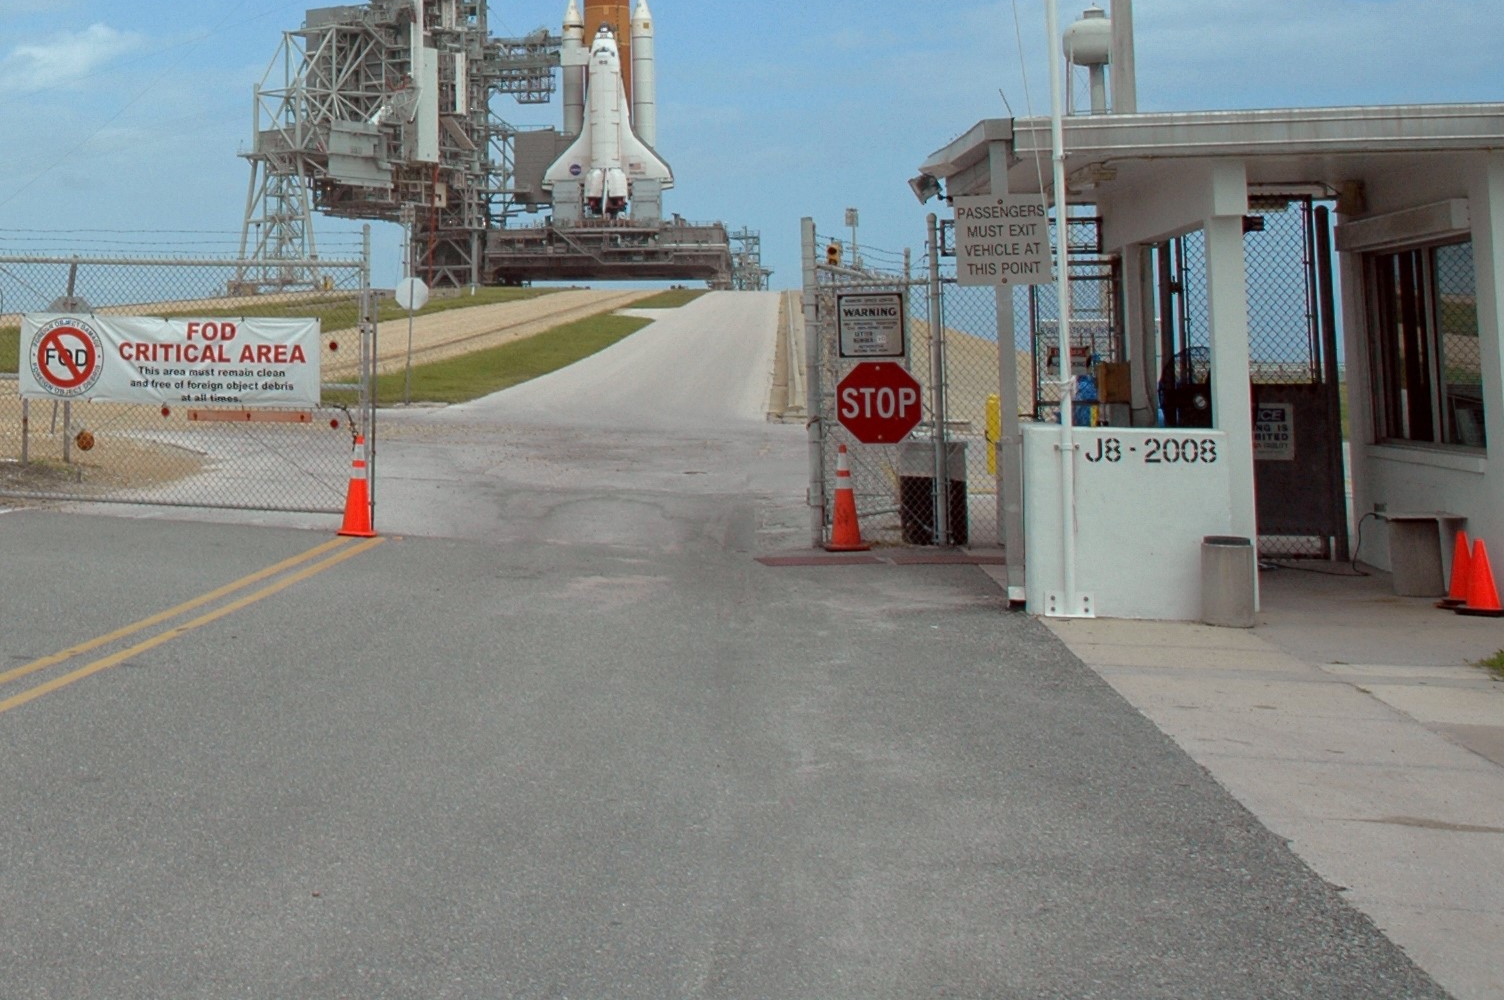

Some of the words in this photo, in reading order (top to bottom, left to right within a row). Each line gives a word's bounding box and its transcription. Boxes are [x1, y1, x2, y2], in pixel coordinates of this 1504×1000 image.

[957, 204, 1045, 219] PASSENGERS
[967, 225, 1003, 238] MUST
[1009, 223, 1038, 237] EXIT
[965, 244, 1019, 257] VEHICLE
[1025, 242, 1040, 255] AT
[967, 263, 996, 276] THIS
[1001, 261, 1040, 275] POINT
[843, 307, 897, 317] WARNING
[186, 322, 237, 341] FOD
[45, 348, 88, 367] FOD
[118, 343, 231, 363] CRITICAL
[239, 344, 307, 364] AREA
[138, 366, 160, 375] This
[189, 369, 214, 377] must
[217, 368, 254, 377] remain
[256, 368, 286, 377] clean
[130, 379, 148, 388] and
[151, 379, 171, 389] free
[174, 380, 184, 389] of
[187, 380, 223, 391] foreign
[226, 380, 259, 391] object
[261, 380, 294, 391] debris
[181, 394, 191, 402] at
[195, 394, 207, 402] all
[210, 394, 243, 403] times.
[842, 387, 917, 419] STOP
[1084, 437, 1121, 464] J8
[1144, 437, 1217, 464] 2008
